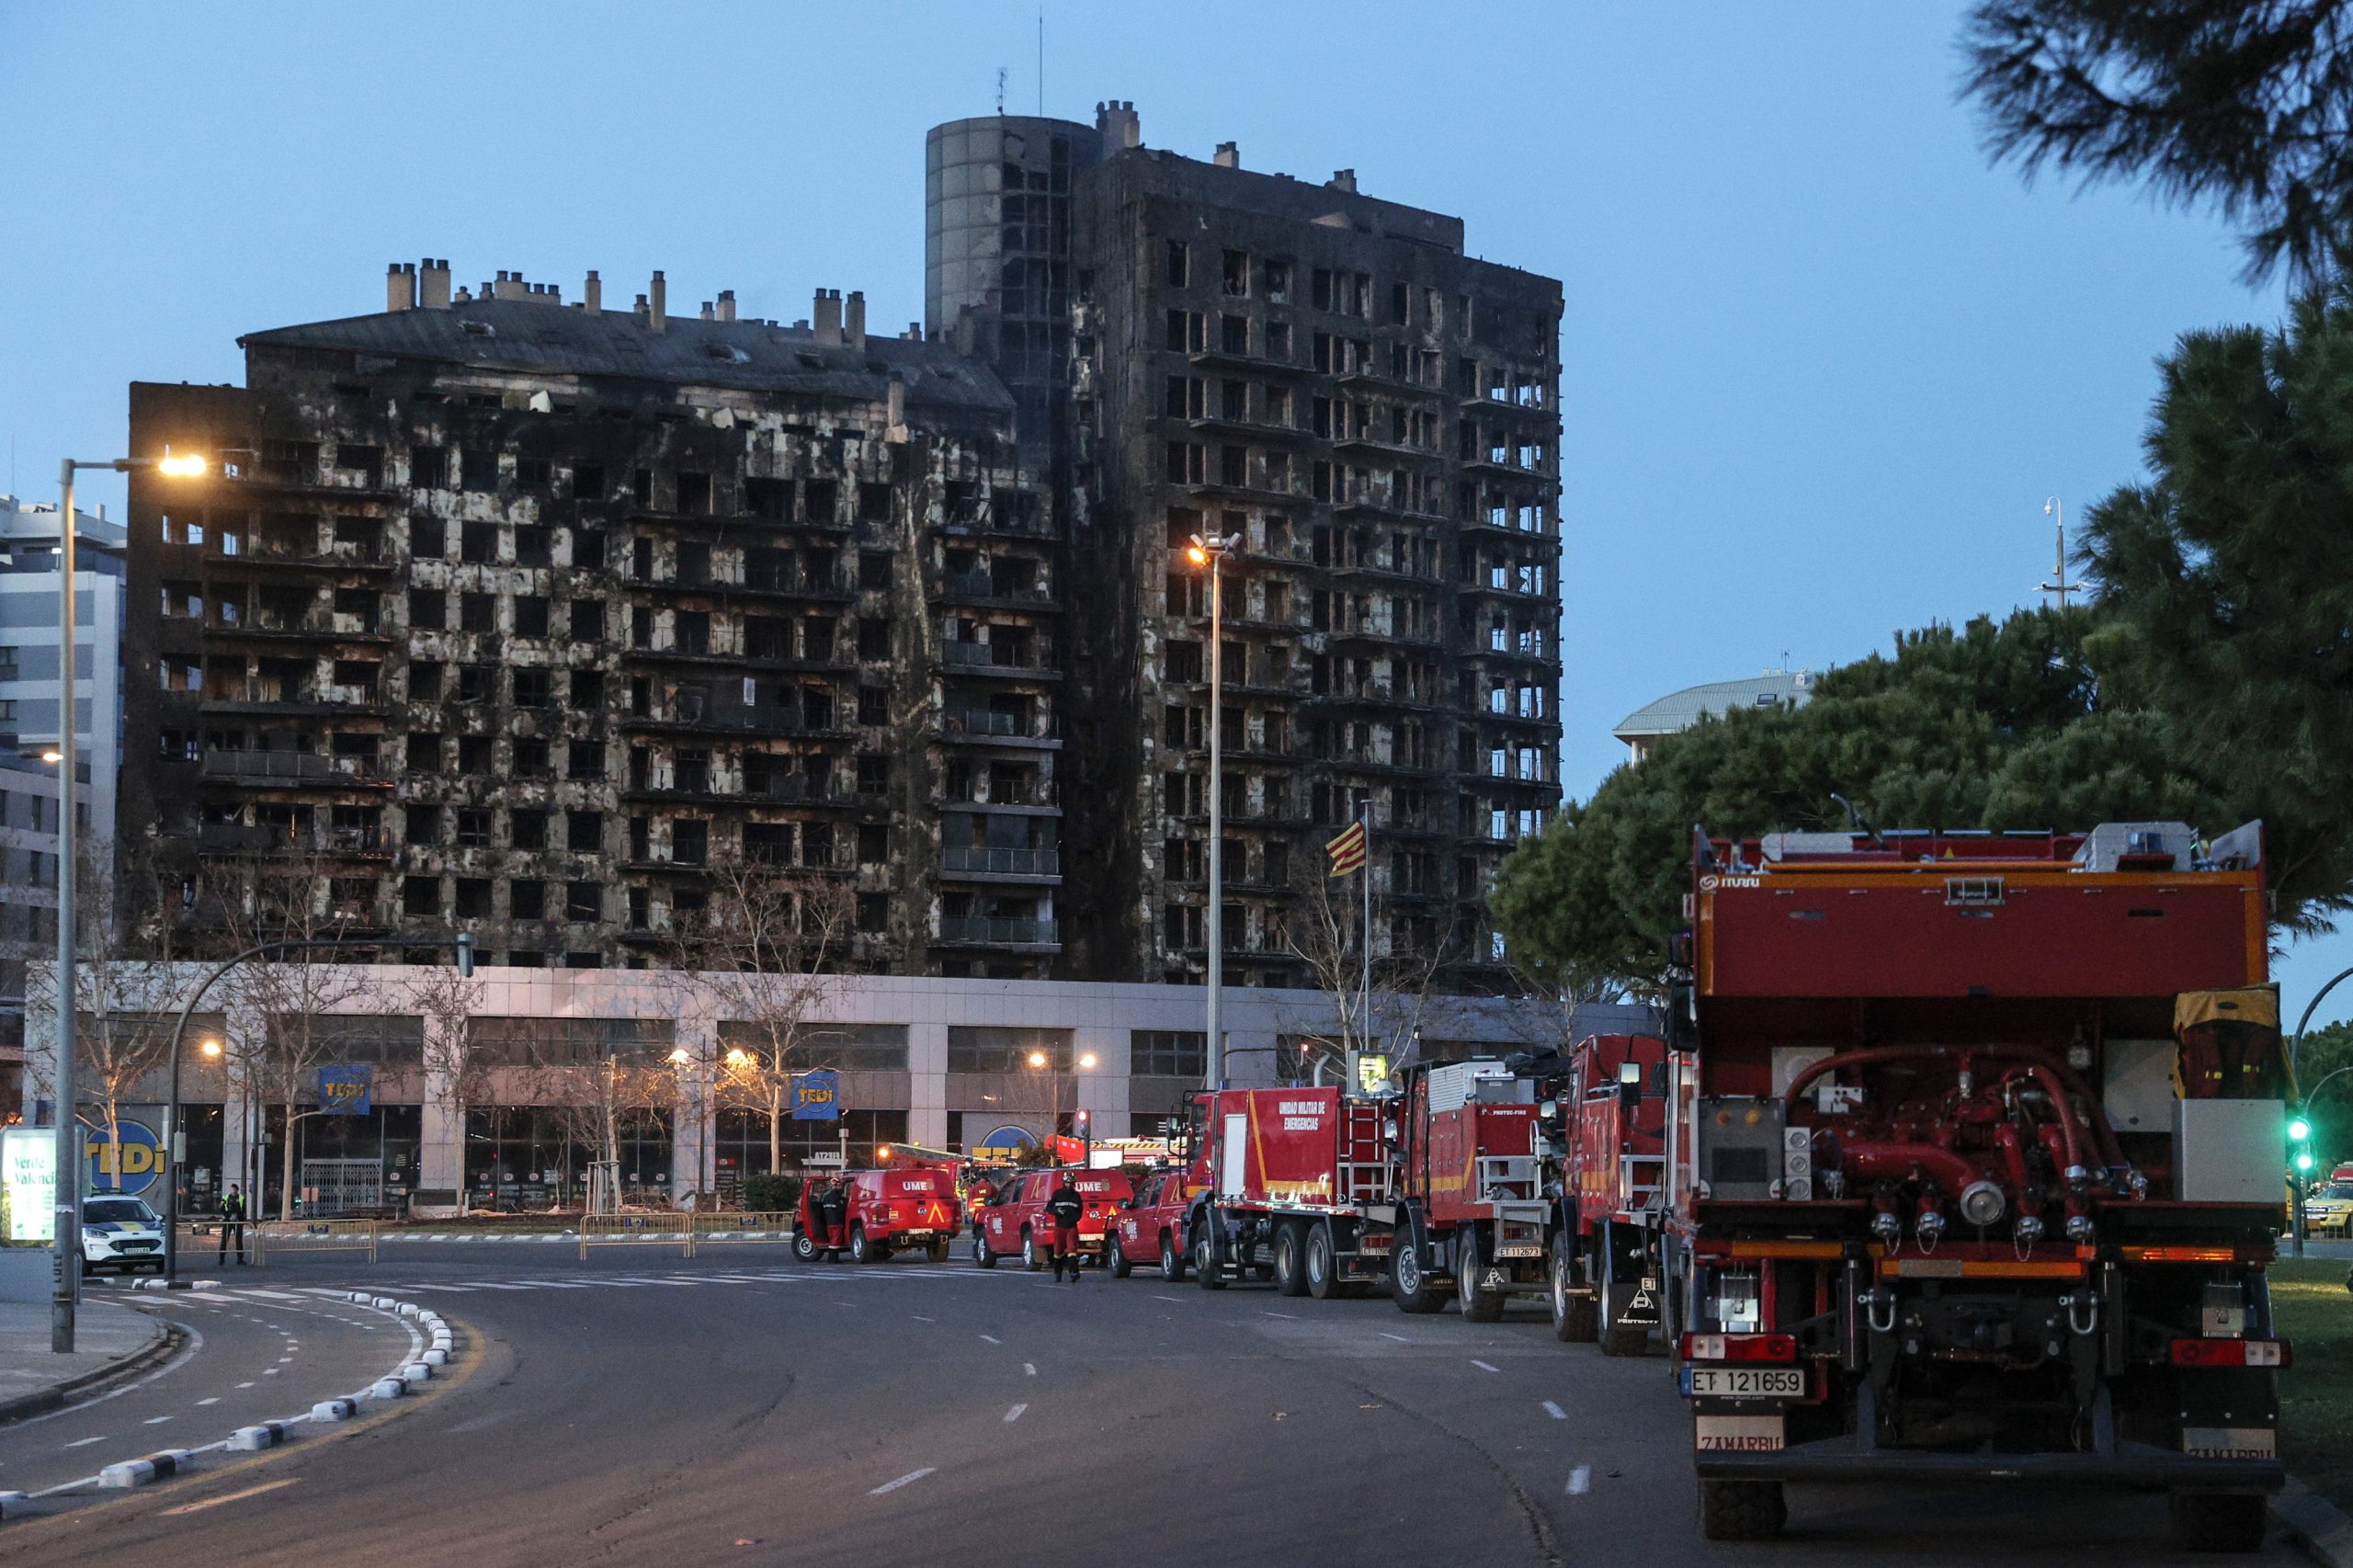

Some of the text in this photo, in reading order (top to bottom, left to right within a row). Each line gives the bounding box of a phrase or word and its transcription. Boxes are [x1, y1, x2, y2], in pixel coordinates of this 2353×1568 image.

[798, 1088, 834, 1103] TEDi
[1279, 1101, 1325, 1115] UNIDAD MILITAR DE
[1284, 1117, 1319, 1131] EMERGENCIAS
[14, 1156, 45, 1169] Verde
[903, 1181, 927, 1191] UME
[1074, 1181, 1103, 1193] UME
[1500, 1248, 1539, 1256] ET 112673
[1643, 1278, 1654, 1289] ET
[1693, 1372, 1800, 1392] ET 121659
